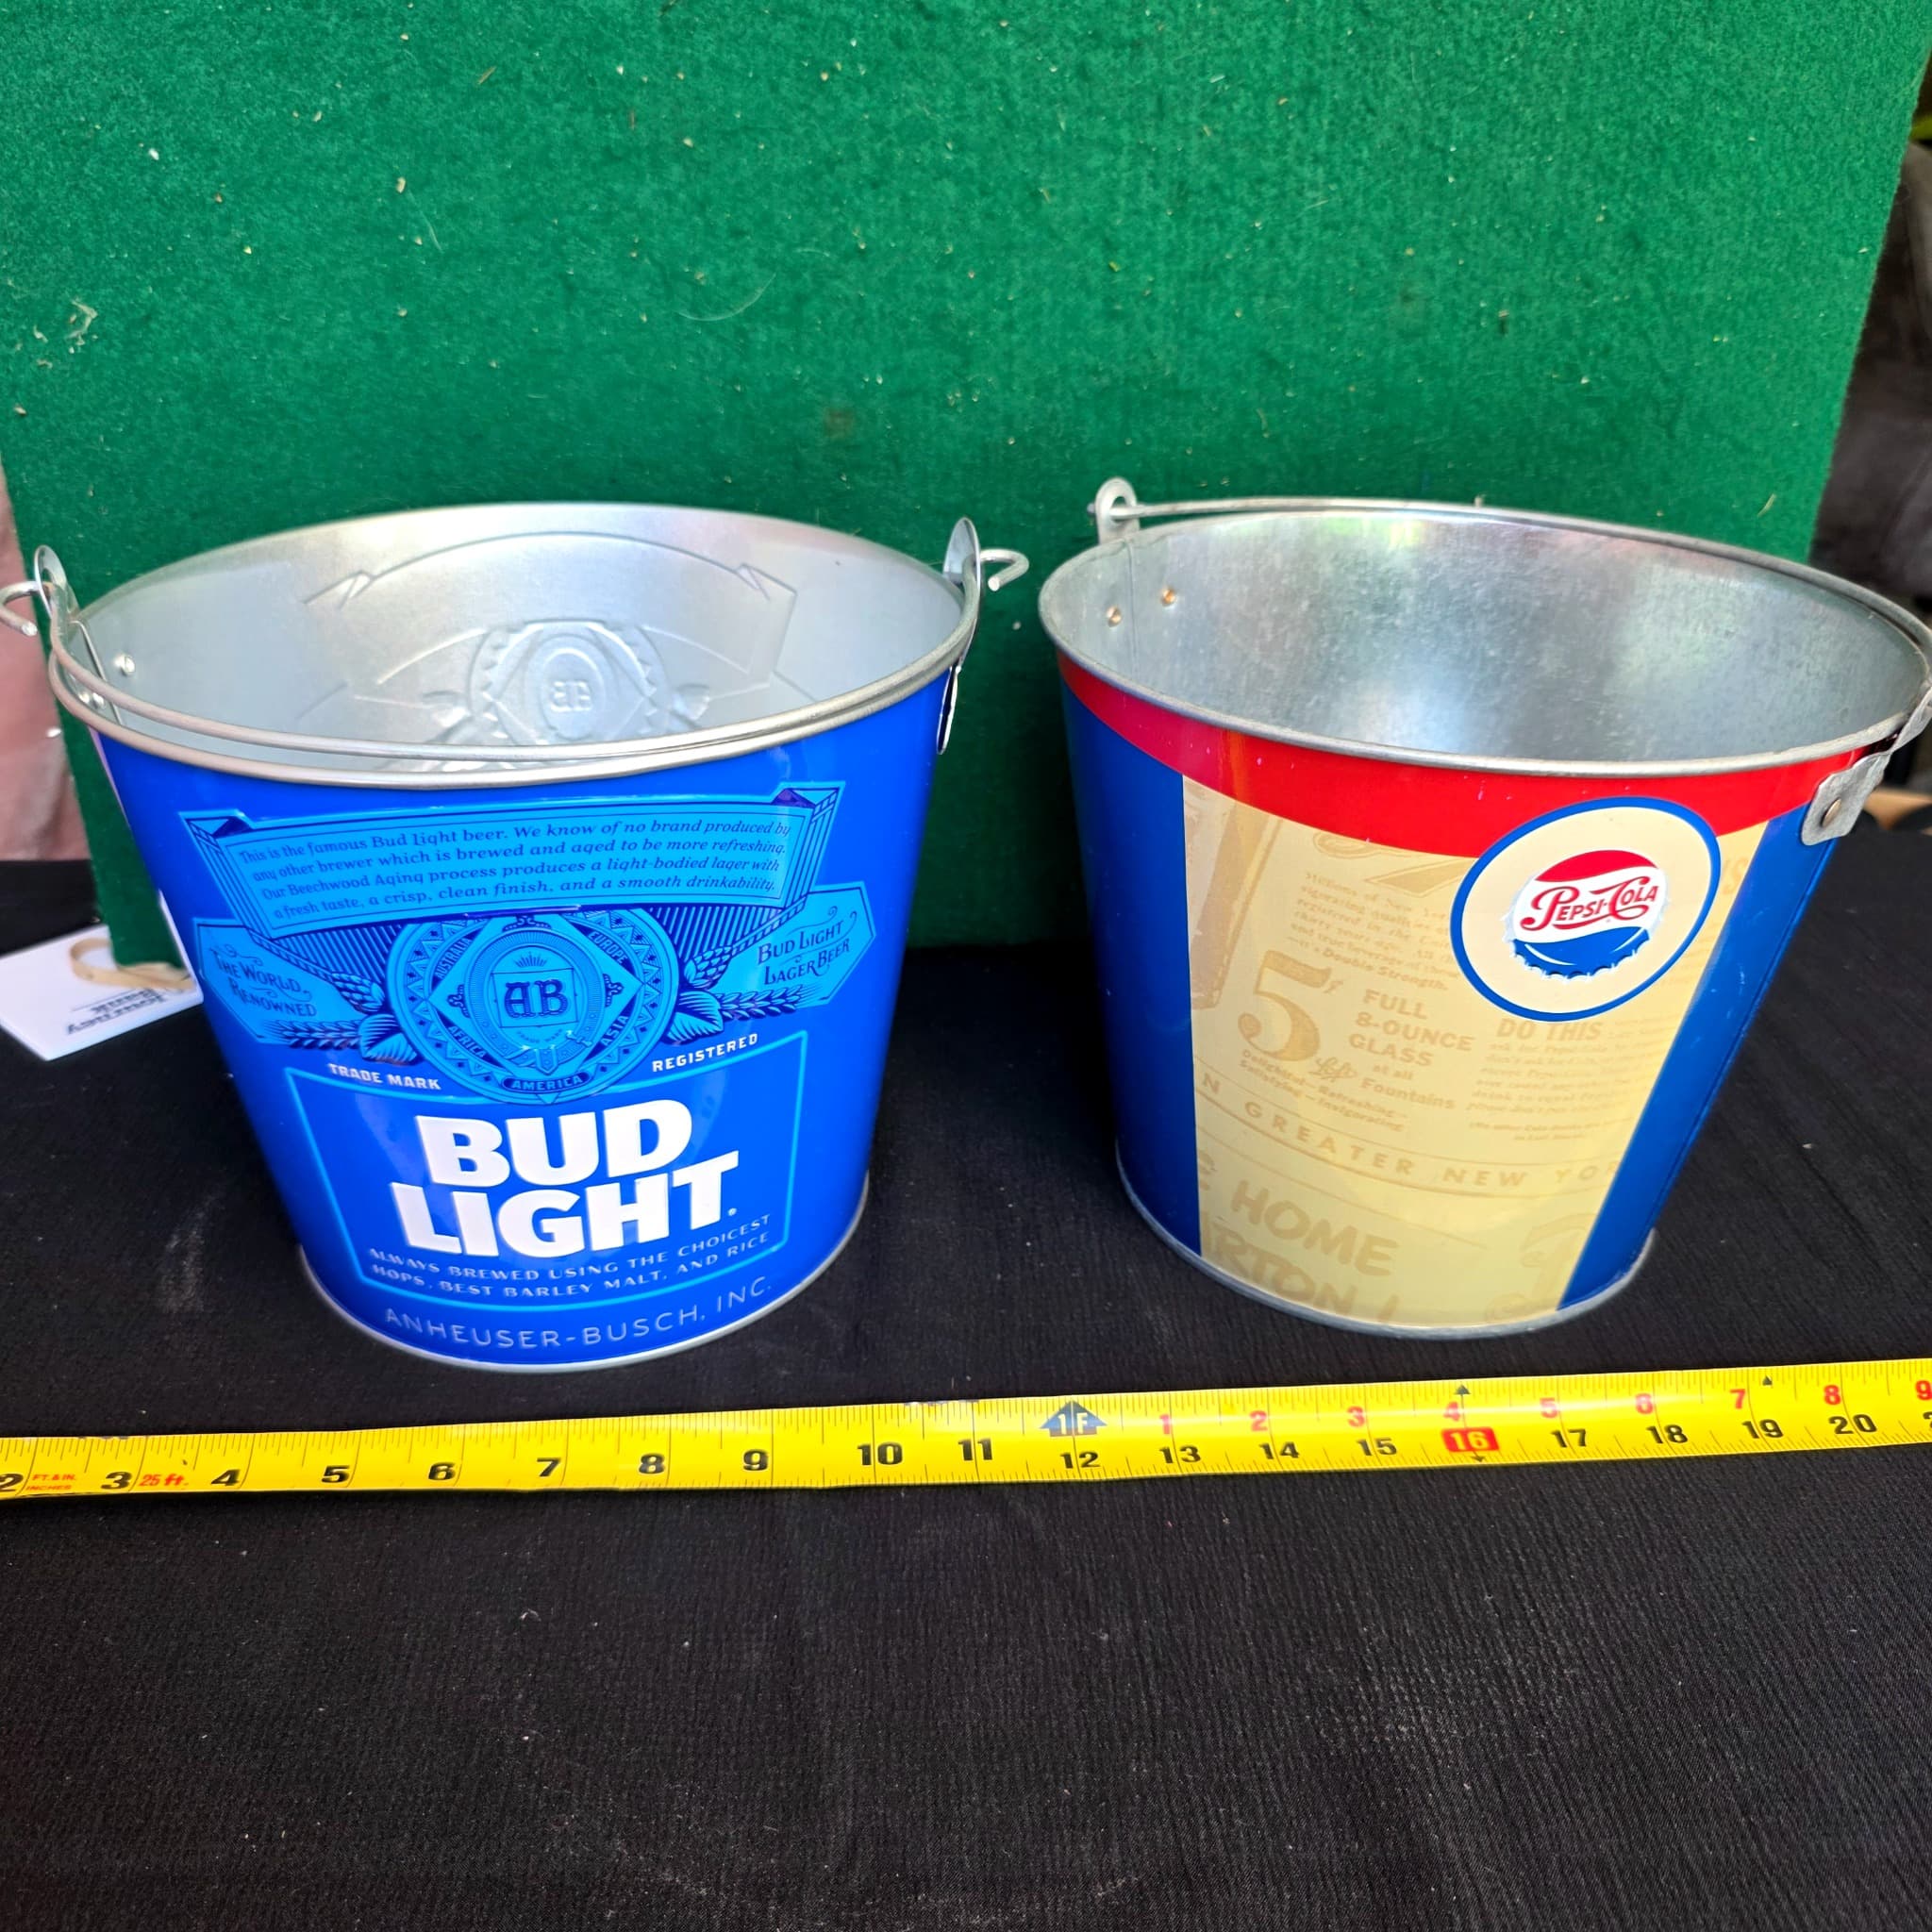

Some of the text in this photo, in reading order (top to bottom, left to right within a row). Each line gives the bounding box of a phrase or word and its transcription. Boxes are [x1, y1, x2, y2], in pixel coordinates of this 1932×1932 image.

[240, 819, 791, 864] This is the famous Bud Light beer. We know of no brand produced by
[252, 868, 278, 884] any
[278, 863, 314, 878] other
[319, 858, 374, 874] brewer
[376, 851, 432, 868] which
[435, 849, 451, 862] is
[456, 845, 525, 861] brewed
[529, 842, 566, 858] and
[570, 840, 616, 857] aged
[620, 839, 639, 851] to
[641, 838, 661, 851] be
[665, 840, 708, 851] more
[261, 887, 286, 901] Our
[287, 879, 371, 899] Beechwood
[374, 873, 425, 889] Aging
[428, 867, 497, 884] process
[501, 859, 587, 878] produces
[591, 860, 603, 871] a
[710, 858, 750, 874] lager
[751, 858, 781, 874] with
[283, 902, 320, 922] fresh
[368, 896, 380, 907] a
[437, 884, 489, 900] clean
[559, 877, 597, 892] and
[601, 878, 613, 889] a
[617, 874, 682, 890] smooth
[435, 936, 473, 979] AUSTRALIA
[587, 930, 628, 965] EUROPE
[242, 960, 302, 993] WORLD
[504, 977, 571, 1019] AB
[1363, 988, 1429, 1021] FULL
[447, 1024, 487, 1059] AFRICA
[600, 1014, 630, 1047] ASIA
[1348, 1032, 1435, 1068] GLASS
[1355, 1010, 1476, 1053] 8-OUNCE
[1496, 1017, 1538, 1041] DO
[1544, 1020, 1605, 1042] THIS
[652, 1032, 759, 1074] REGISTERED
[1371, 1062, 1391, 1075] at
[1393, 1067, 1414, 1081] all
[327, 1062, 442, 1091] TRADE MARK
[510, 1074, 584, 1091] AMERICA
[1360, 1076, 1457, 1110] Fountains
[415, 1099, 693, 1189] BUD
[1244, 1100, 1415, 1176] GREATER
[1441, 1167, 1528, 1189] NEW
[390, 1150, 740, 1258] LIGHT
[369, 1213, 772, 1282] ALWAYS BREWED USING THE CHOICEST
[1229, 1179, 1401, 1277] HOME
[439, 1280, 492, 1296] BEST
[504, 1283, 593, 1298] BARLEY
[677, 1254, 719, 1274] AND
[727, 1230, 770, 1258] RICE
[717, 1275, 773, 1313] INC.
[1057, 1380, 1932, 1436] 1F 1 2 3 4 5 6 7 8 9
[0, 1413, 1878, 1493] 2 3 4 5 6 7 8 9 10 11 12 13 14 15 16 17 18 19 20
[139, 1474, 160, 1487] 25
